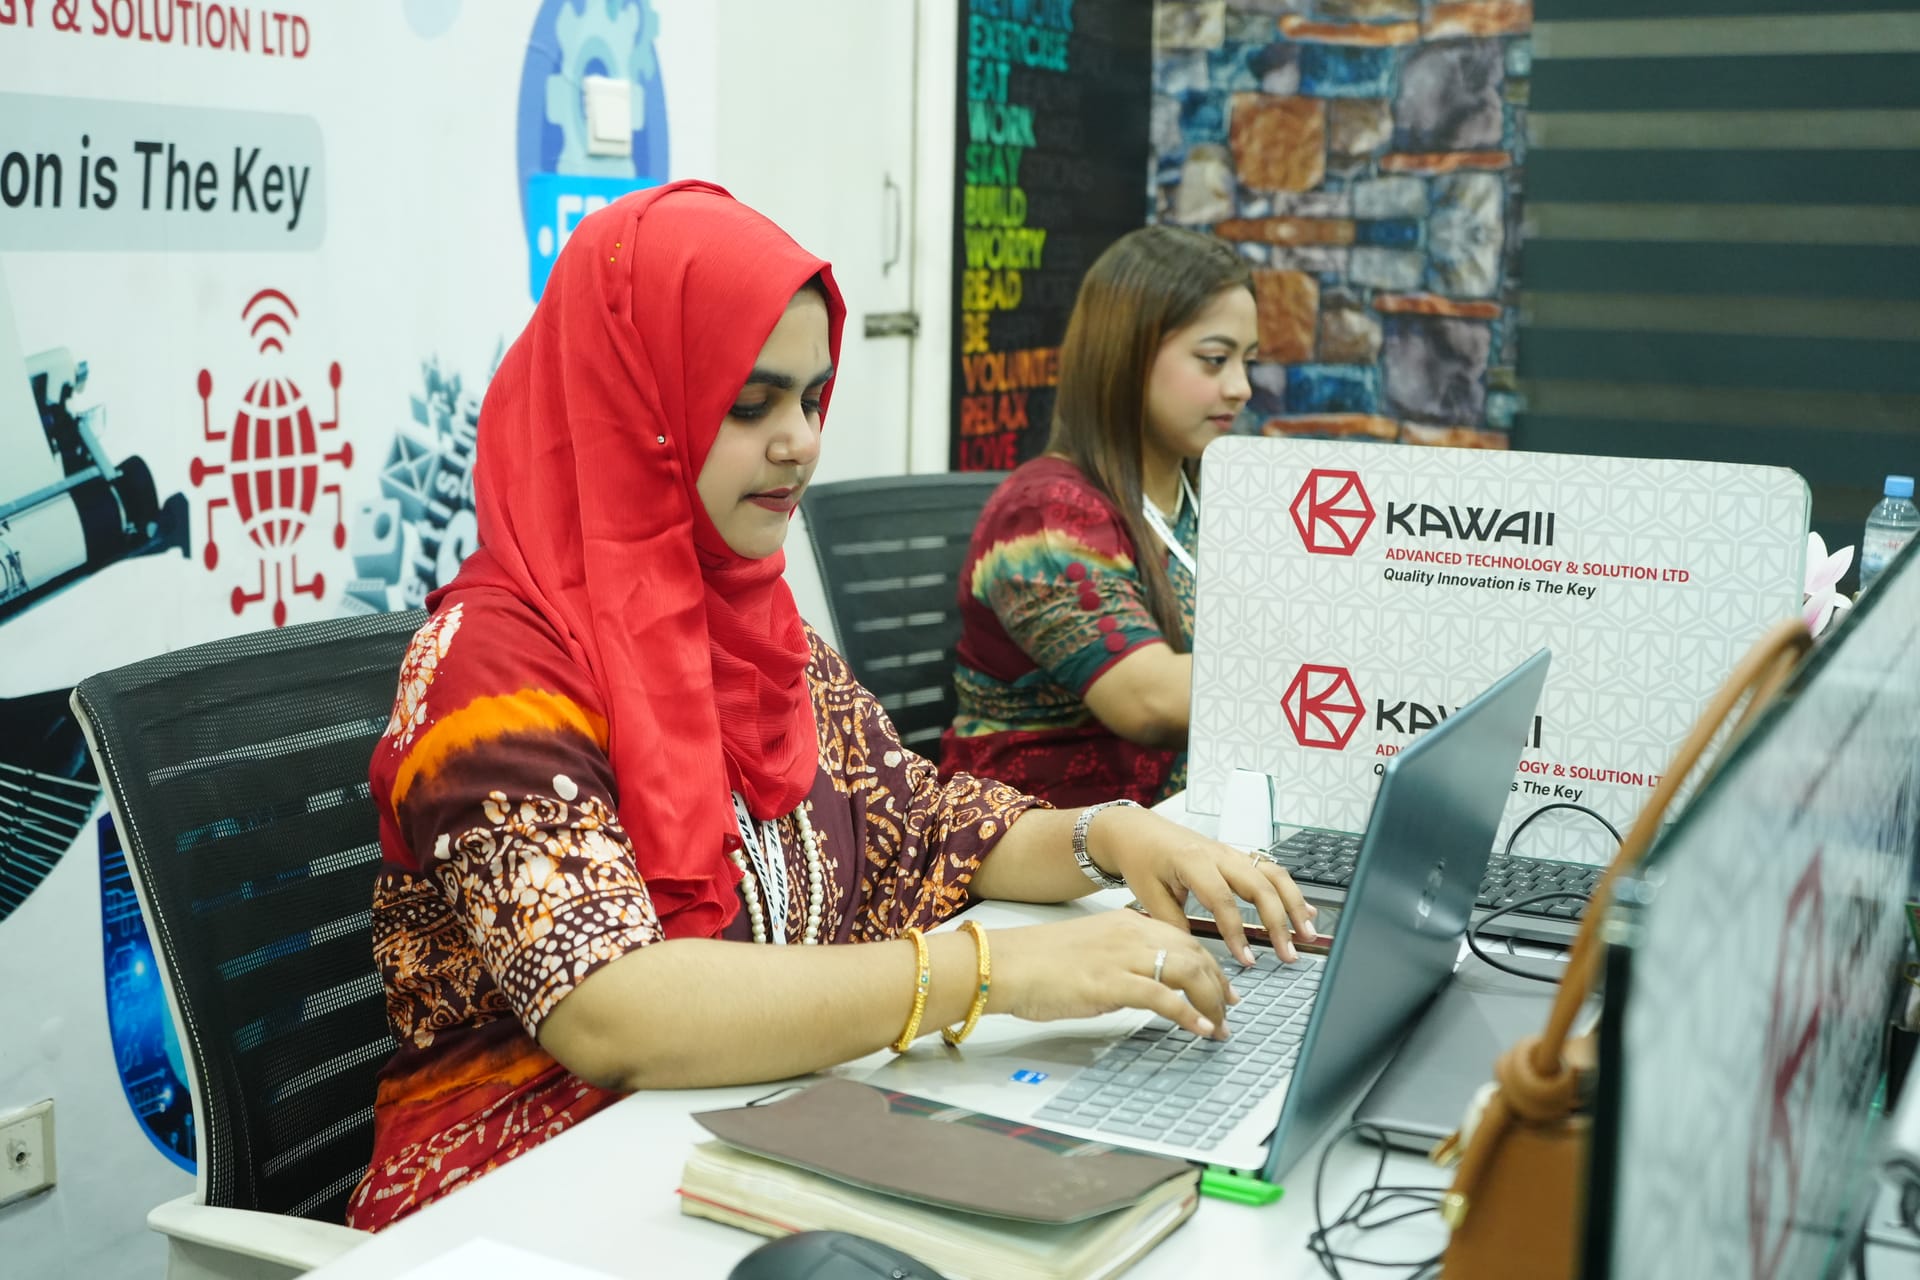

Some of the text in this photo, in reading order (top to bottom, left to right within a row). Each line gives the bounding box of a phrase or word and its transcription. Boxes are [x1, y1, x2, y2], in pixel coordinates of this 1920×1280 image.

[92, 0, 250, 52] SOLUTION
[262, 10, 310, 58] LTD
[967, 101, 1036, 147] WORK
[0, 134, 310, 231] on is The Key
[965, 143, 1022, 187] STAY
[962, 269, 1022, 310] READ
[961, 392, 1029, 436] RELAX
[960, 431, 1018, 473] LOVE
[1386, 502, 1556, 546] KAWAII
[1383, 568, 1596, 600] Quality Innovation is The Key
[1385, 548, 1690, 583] ADVANCED TECHNOLOGY & SOLUTION LTD
[1523, 781, 1551, 796] The
[1554, 784, 1582, 802] Key
[1553, 764, 1566, 777] &
[1569, 766, 1643, 786] SOLUTION
[1648, 775, 1665, 788] LT
